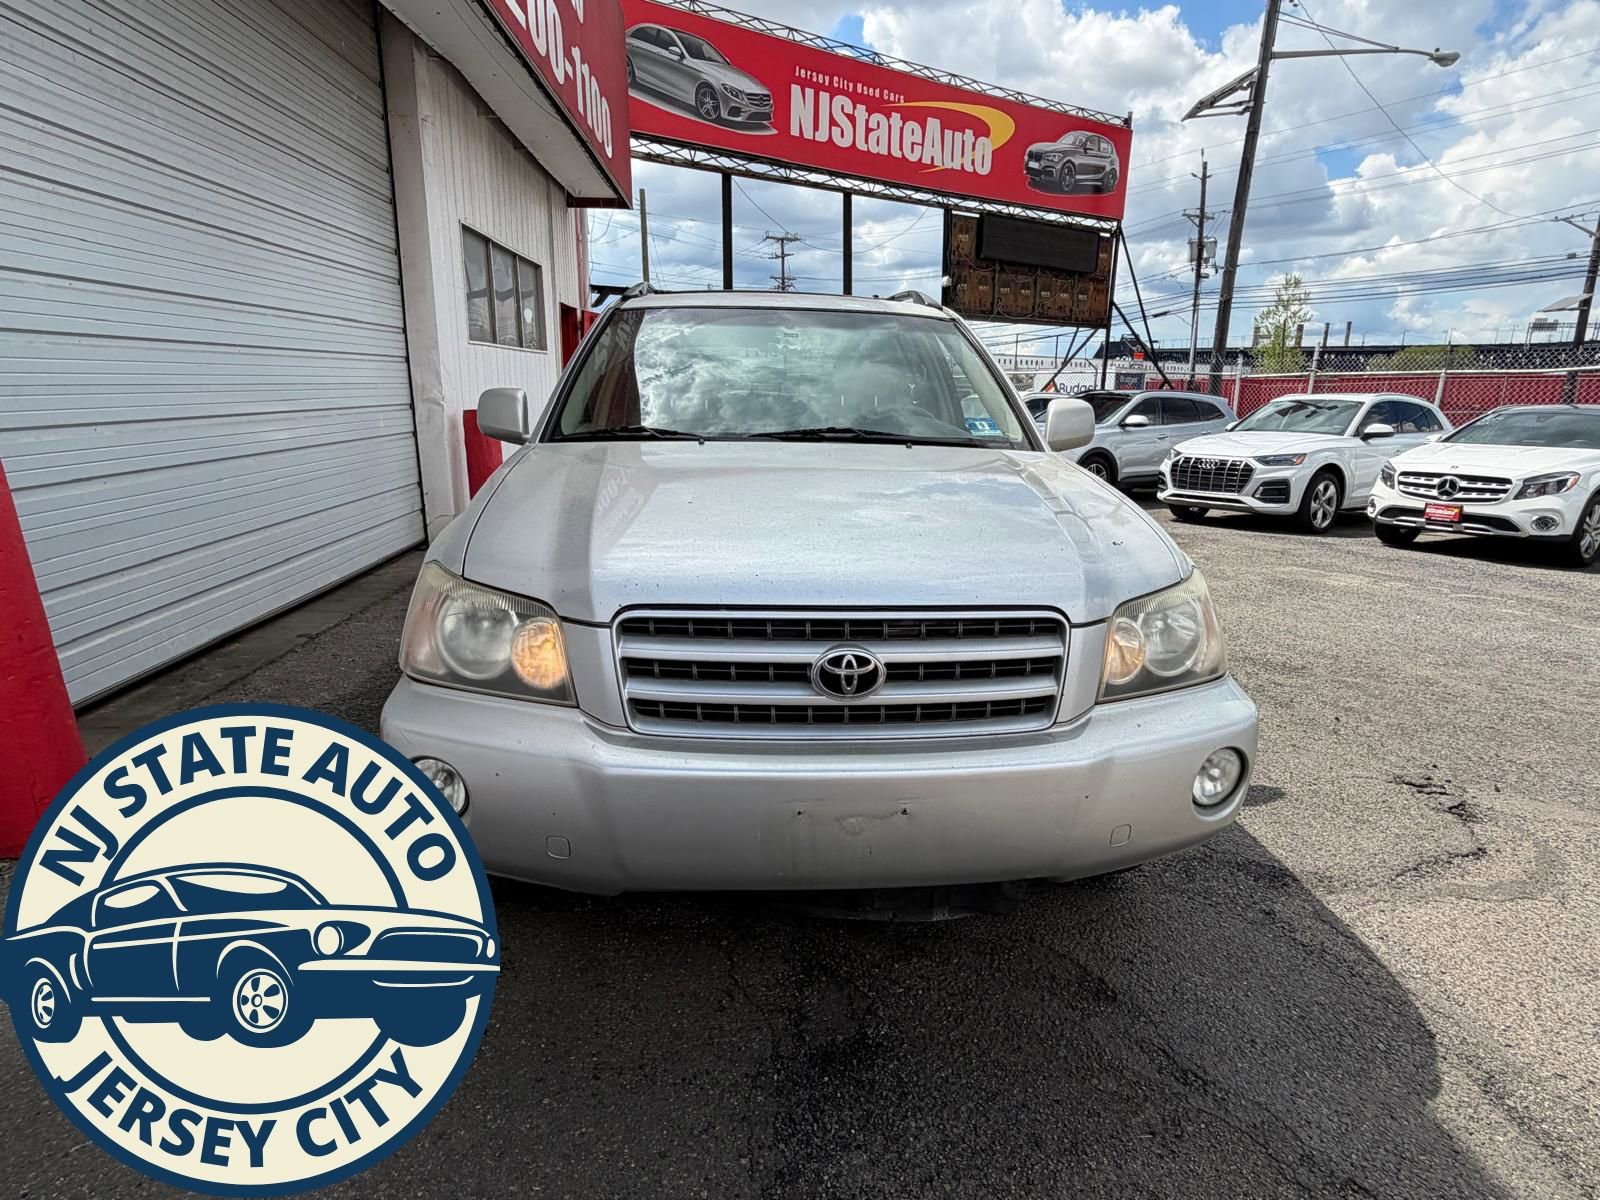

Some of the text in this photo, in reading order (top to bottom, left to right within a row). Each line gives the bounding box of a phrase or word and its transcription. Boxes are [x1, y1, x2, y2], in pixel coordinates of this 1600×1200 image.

[795, 65, 905, 104] Jersey City Used Cars
[790, 83, 992, 176] NJStateAuto
